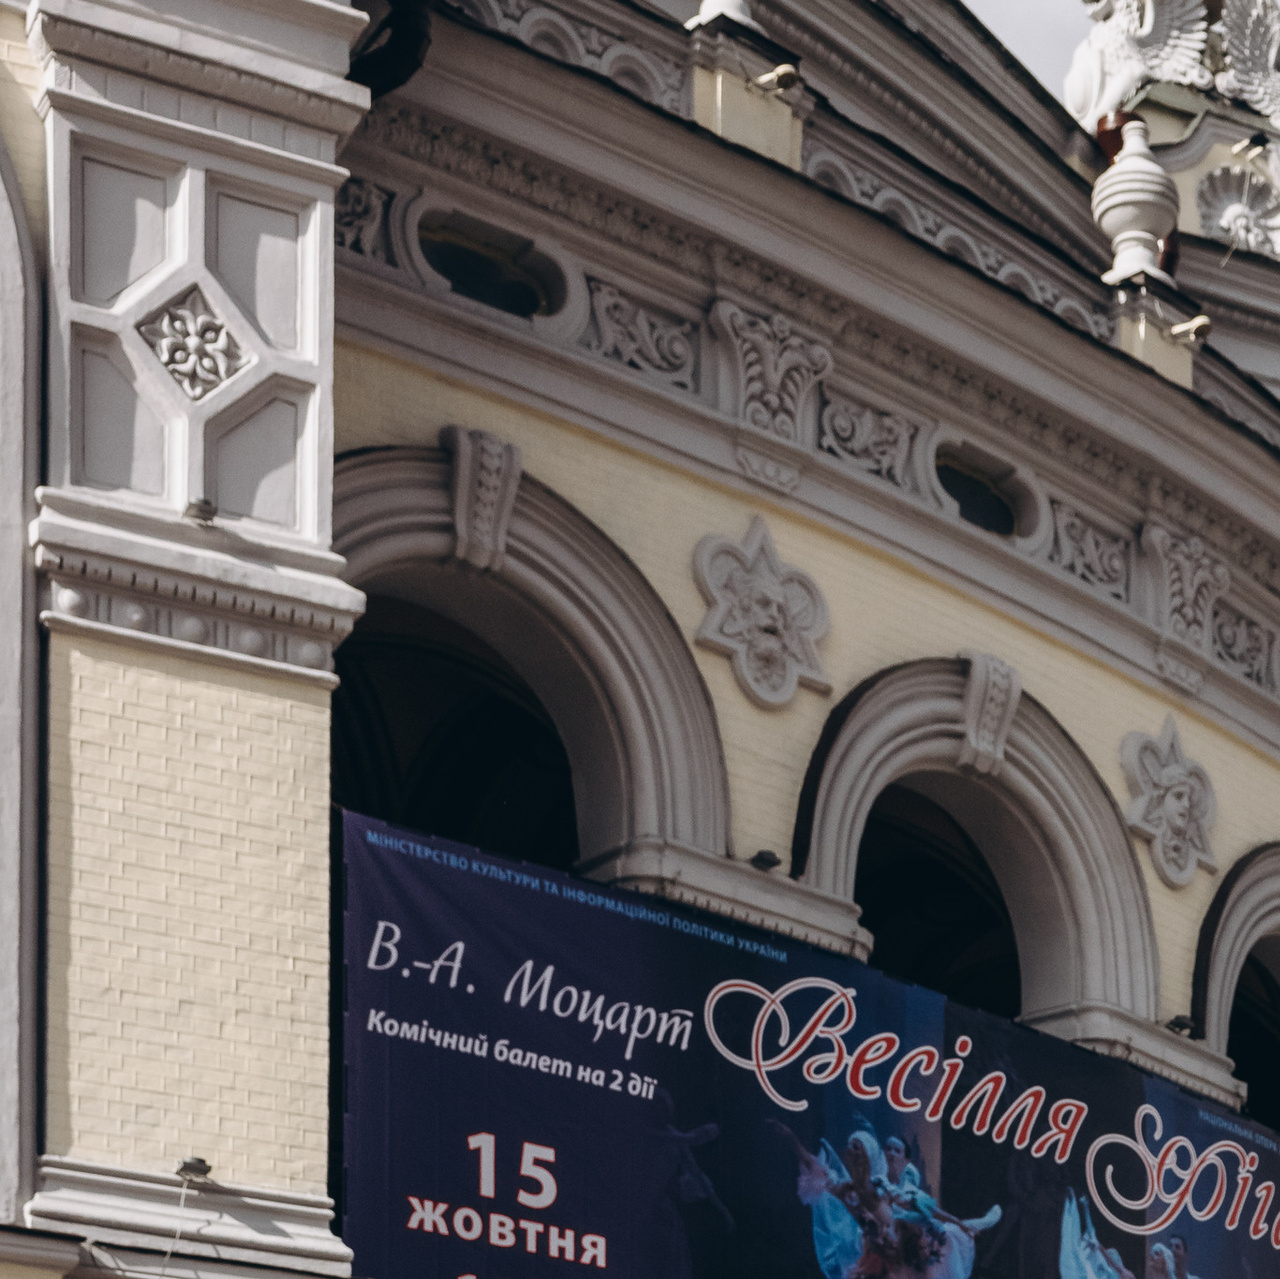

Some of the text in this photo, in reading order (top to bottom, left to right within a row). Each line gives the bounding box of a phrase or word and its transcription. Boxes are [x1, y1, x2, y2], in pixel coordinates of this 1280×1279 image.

[366, 830, 788, 963] МІНІСТЕРСТВО КУЛЬТУРИ ТА ІНФОРМАЦІЙНОЇ ПОЛІТИКИ УКРАЇНИ
[367, 1008, 658, 1100] Комічний балет на 2 дії
[503, 959, 695, 1061] Моцарт
[704, 977, 1088, 1163] Весілля
[467, 1131, 558, 1210] 15
